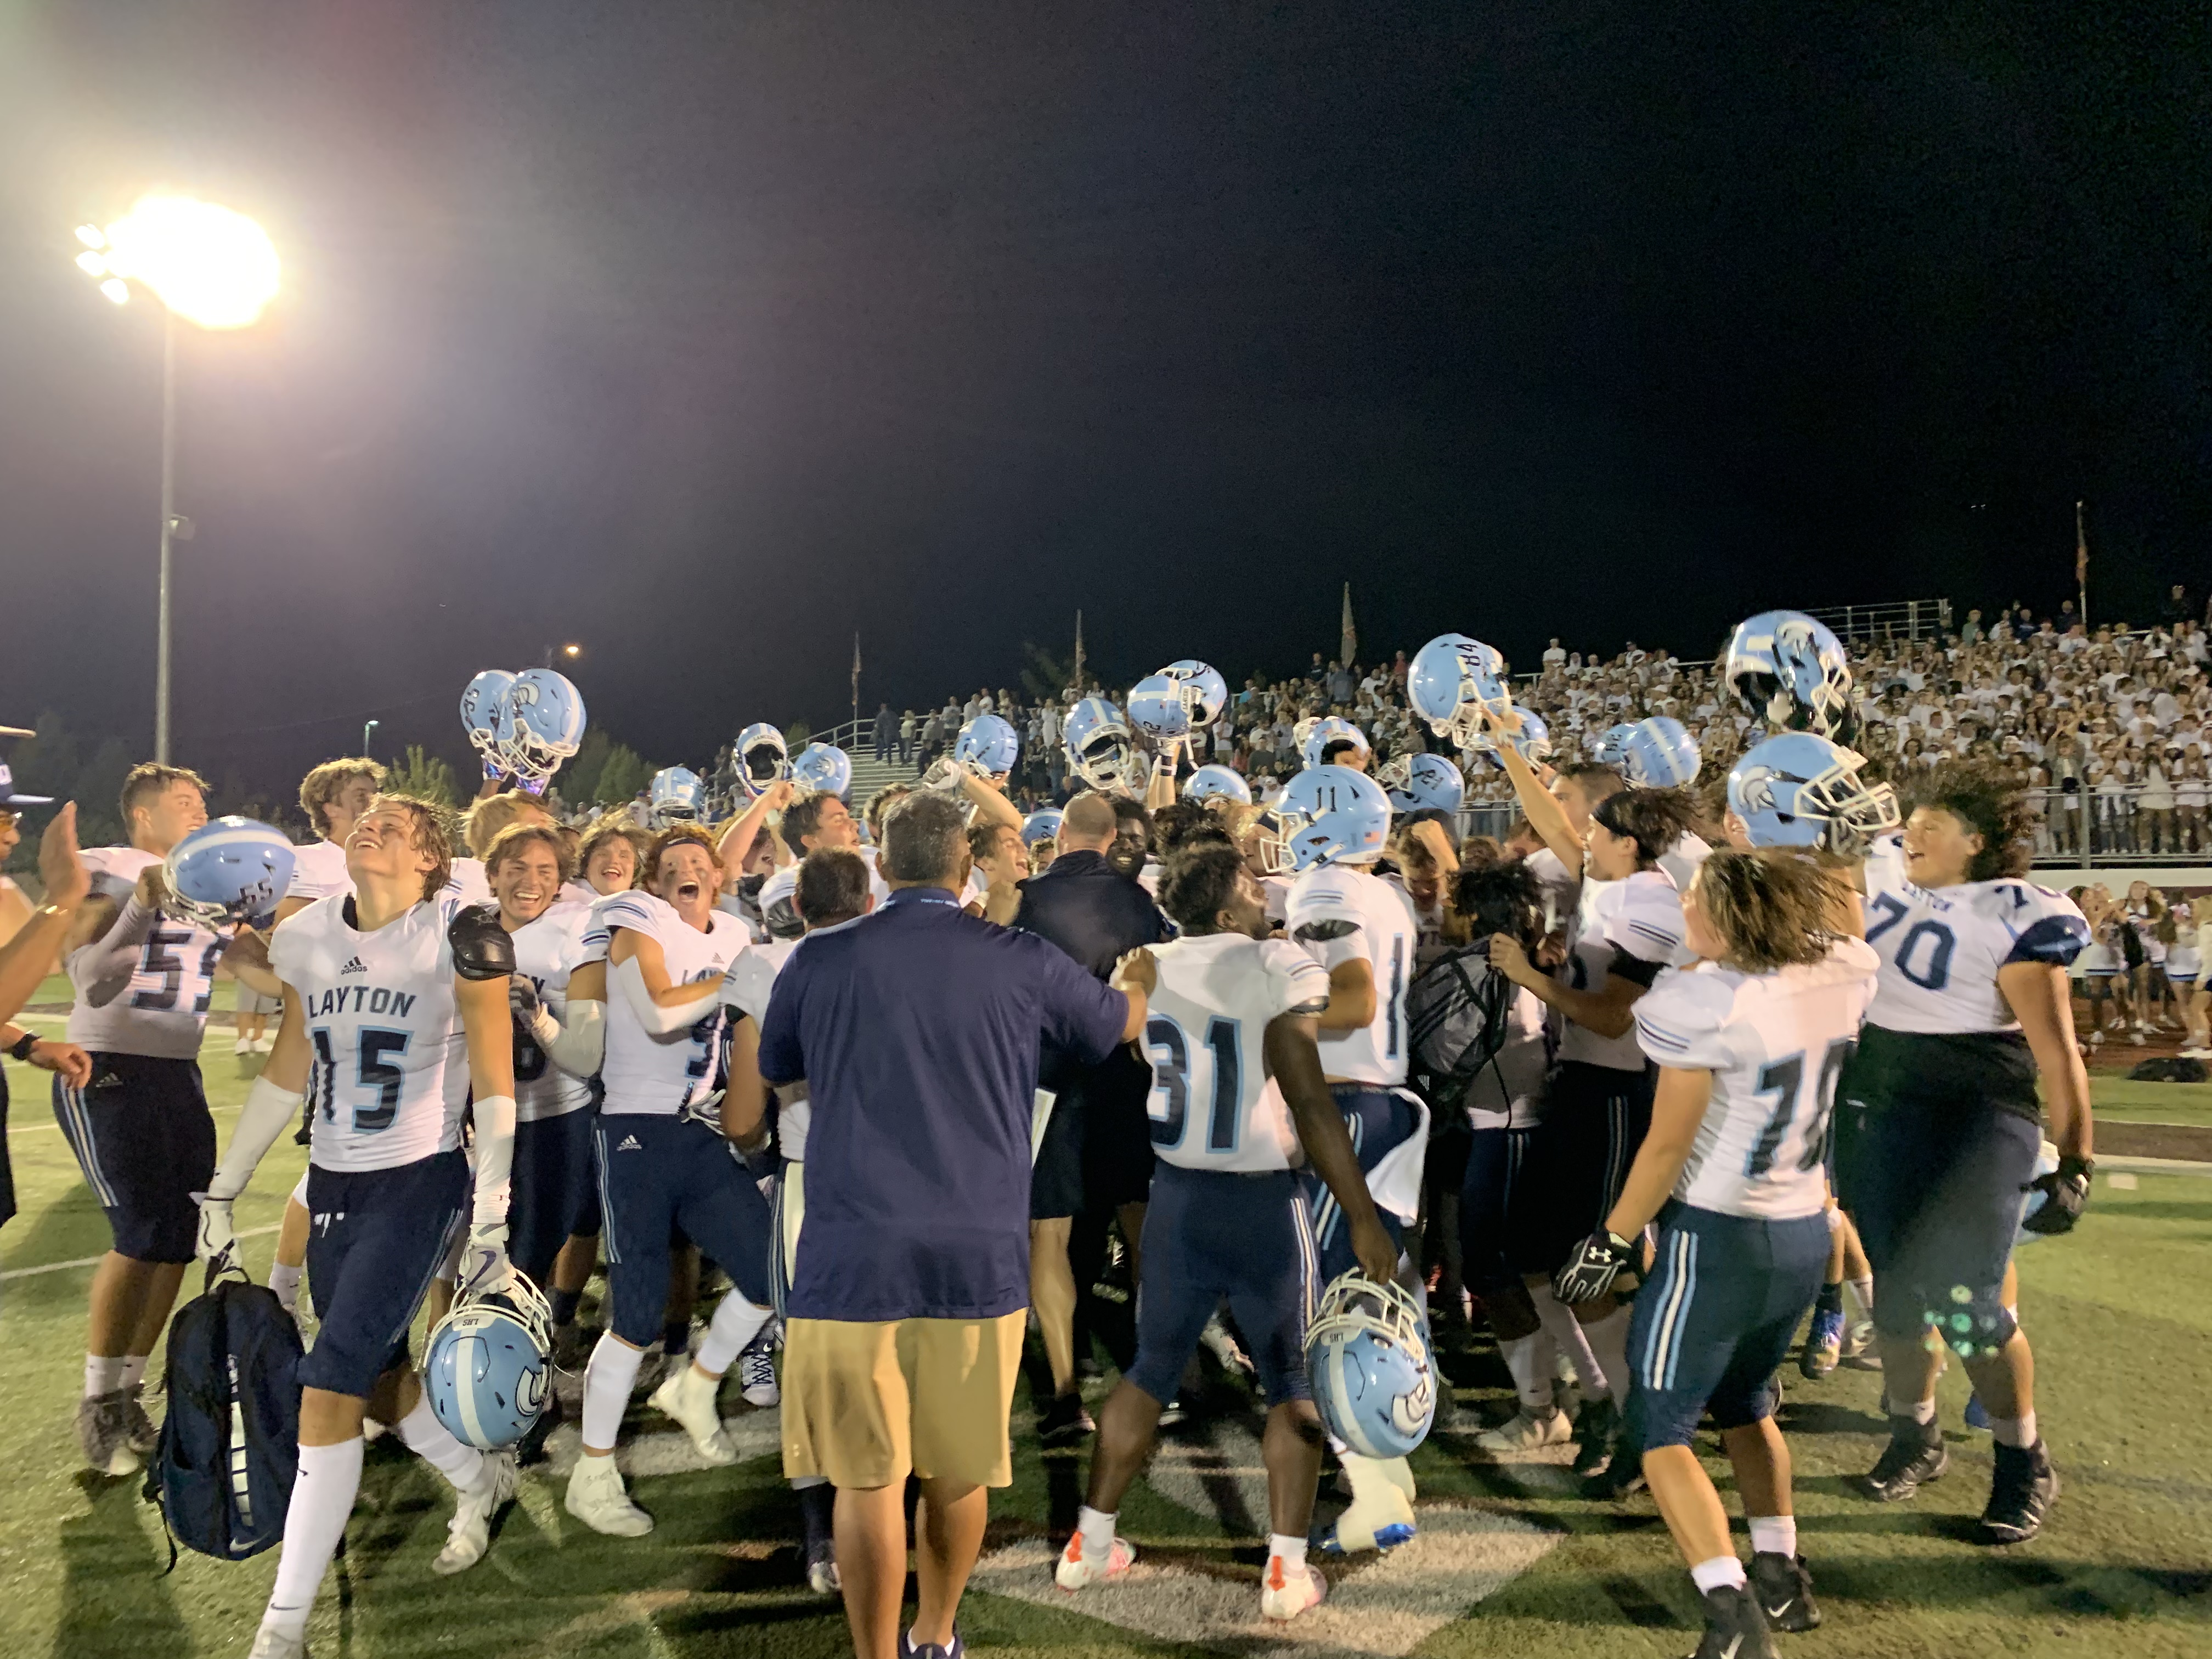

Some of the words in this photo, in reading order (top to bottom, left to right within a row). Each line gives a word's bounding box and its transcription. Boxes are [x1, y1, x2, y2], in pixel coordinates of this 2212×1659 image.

[1316, 786, 1337, 812] 11
[341, 966, 368, 975] adidas
[1865, 890, 1957, 990] 70
[308, 985, 417, 1018] LAYTON
[310, 1024, 415, 1136] 15
[1146, 1013, 1245, 1154] 31
